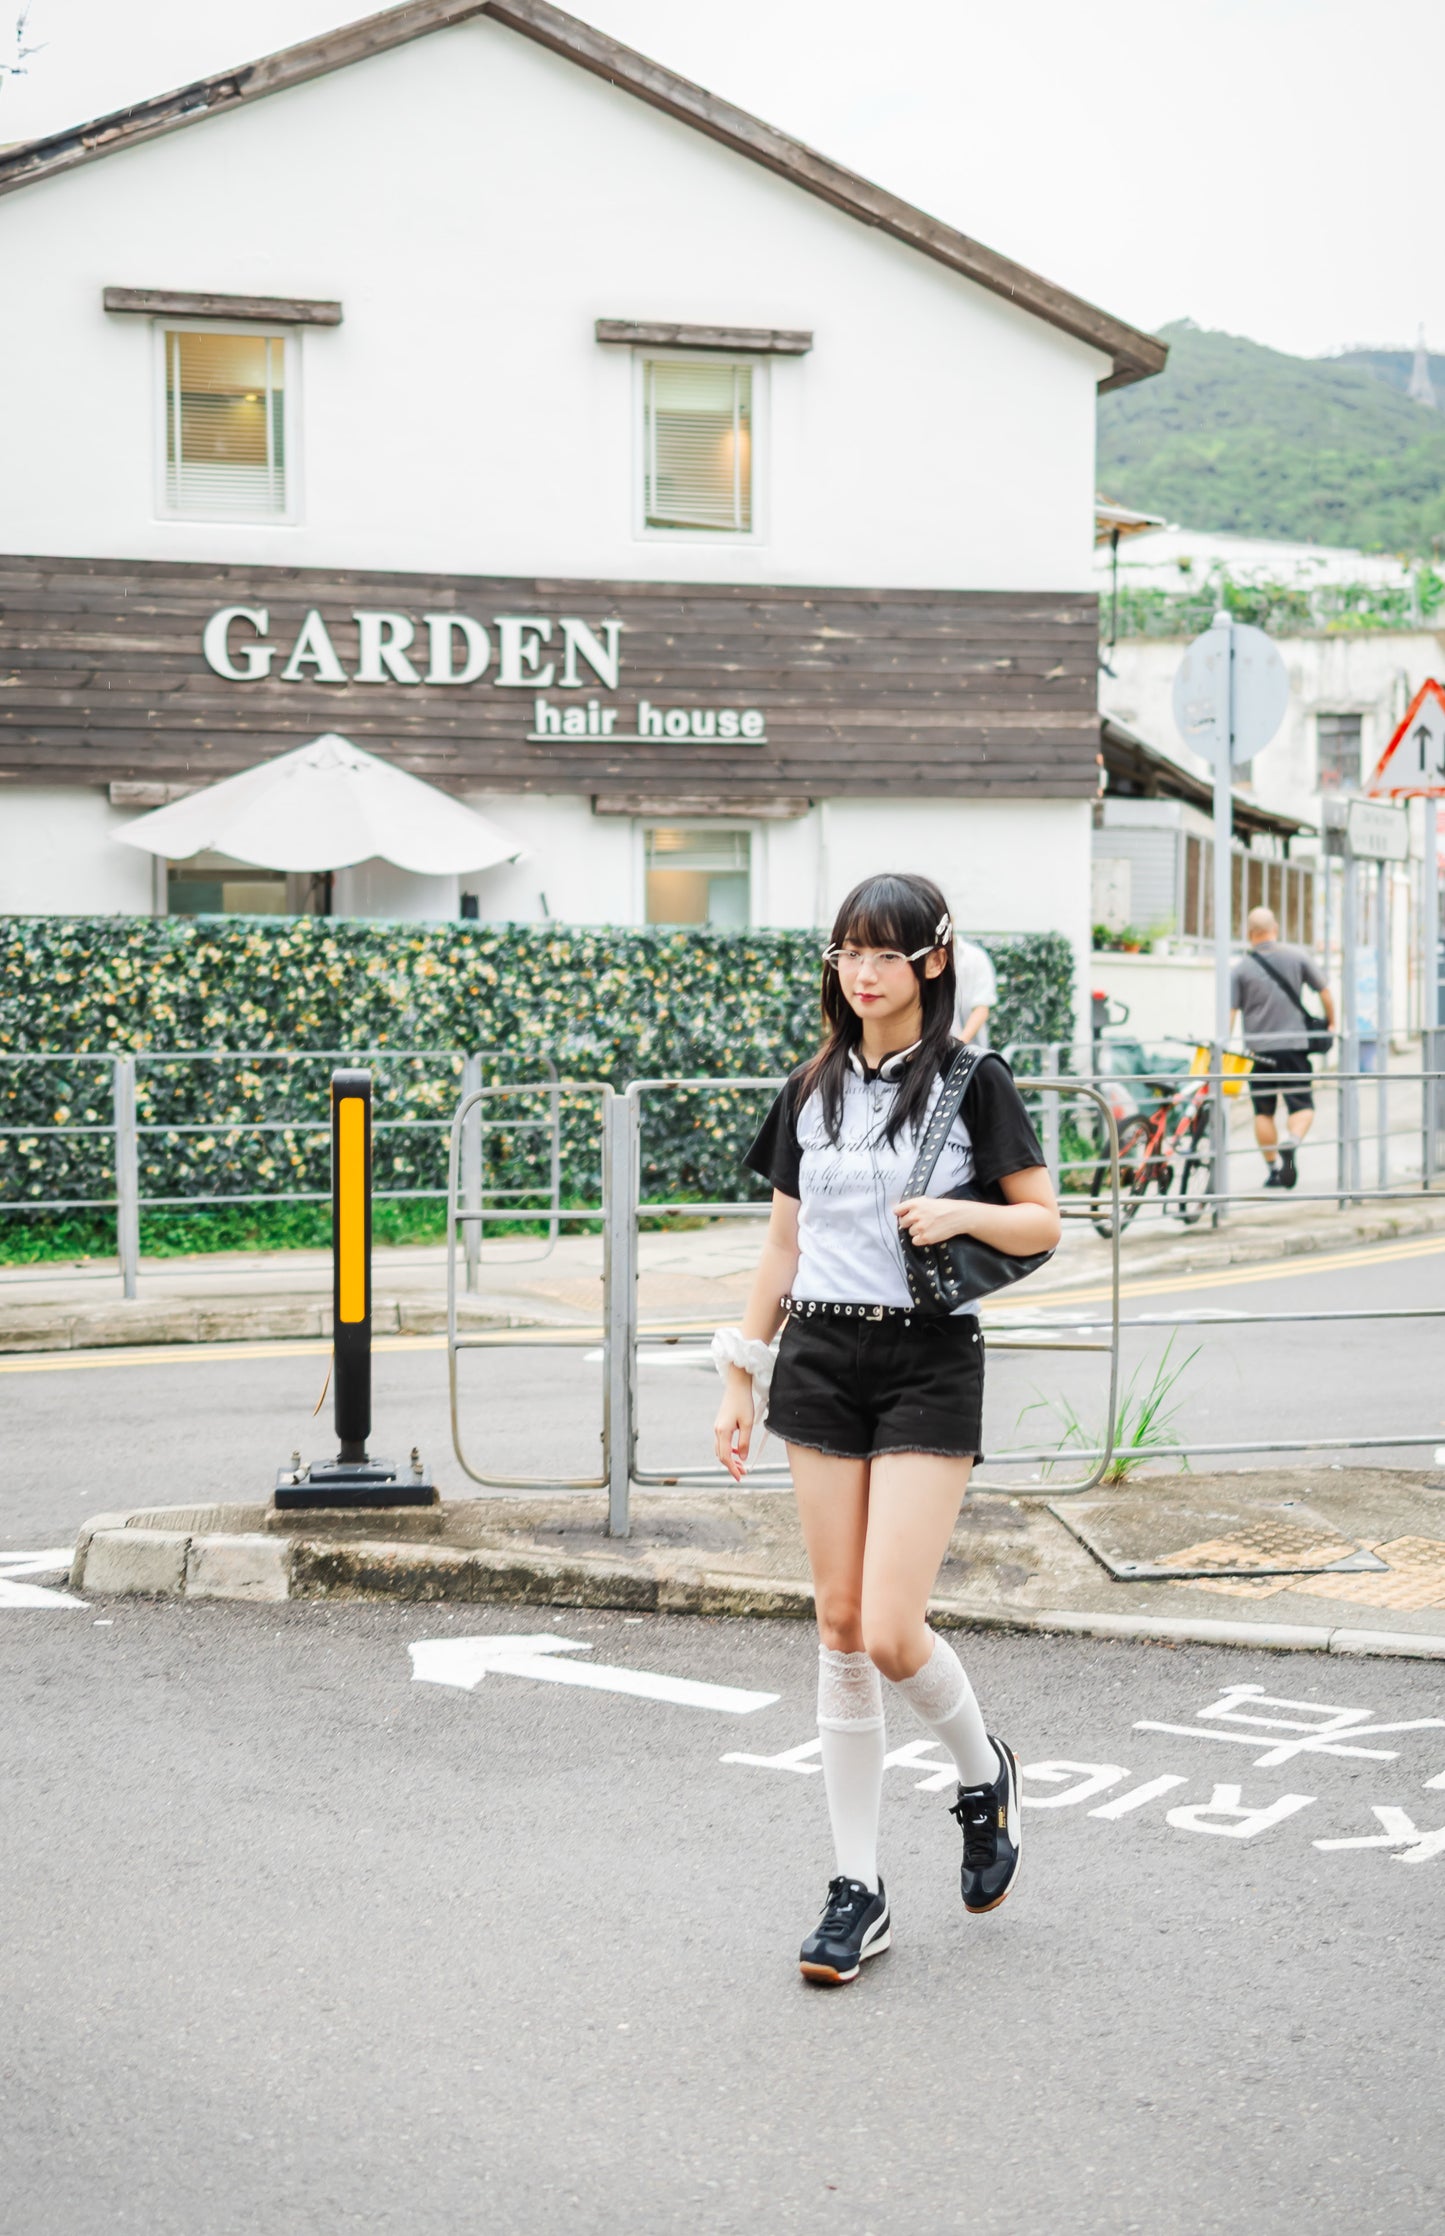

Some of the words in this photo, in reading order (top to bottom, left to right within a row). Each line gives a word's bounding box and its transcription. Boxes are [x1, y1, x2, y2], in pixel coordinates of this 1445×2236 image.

[203, 606, 624, 690] GARDEN
[534, 698, 618, 736] hair
[637, 699, 766, 738] house
[717, 1737, 1319, 1840] RIGHT
